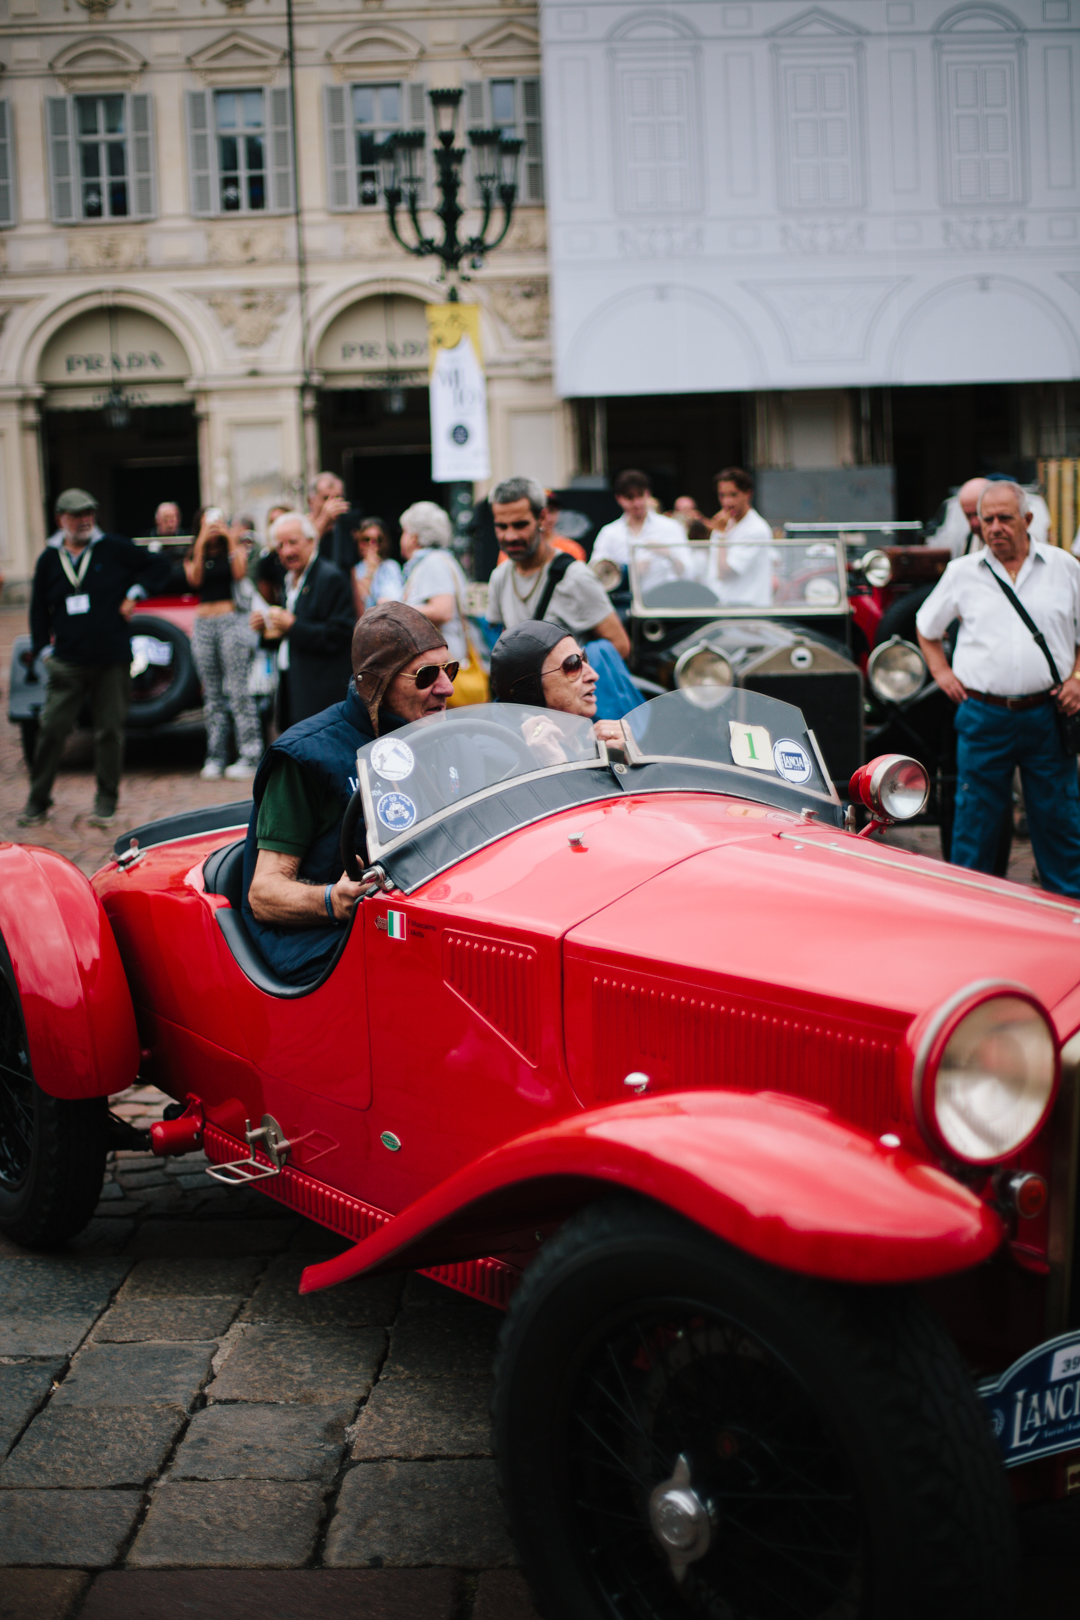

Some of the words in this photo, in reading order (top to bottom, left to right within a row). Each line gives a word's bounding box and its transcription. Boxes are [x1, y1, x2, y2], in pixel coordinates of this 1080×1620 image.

[341, 340, 428, 361] PRAD
[65, 350, 166, 374] PRADA
[743, 732, 760, 761] 1
[782, 753, 804, 768] LANCIA
